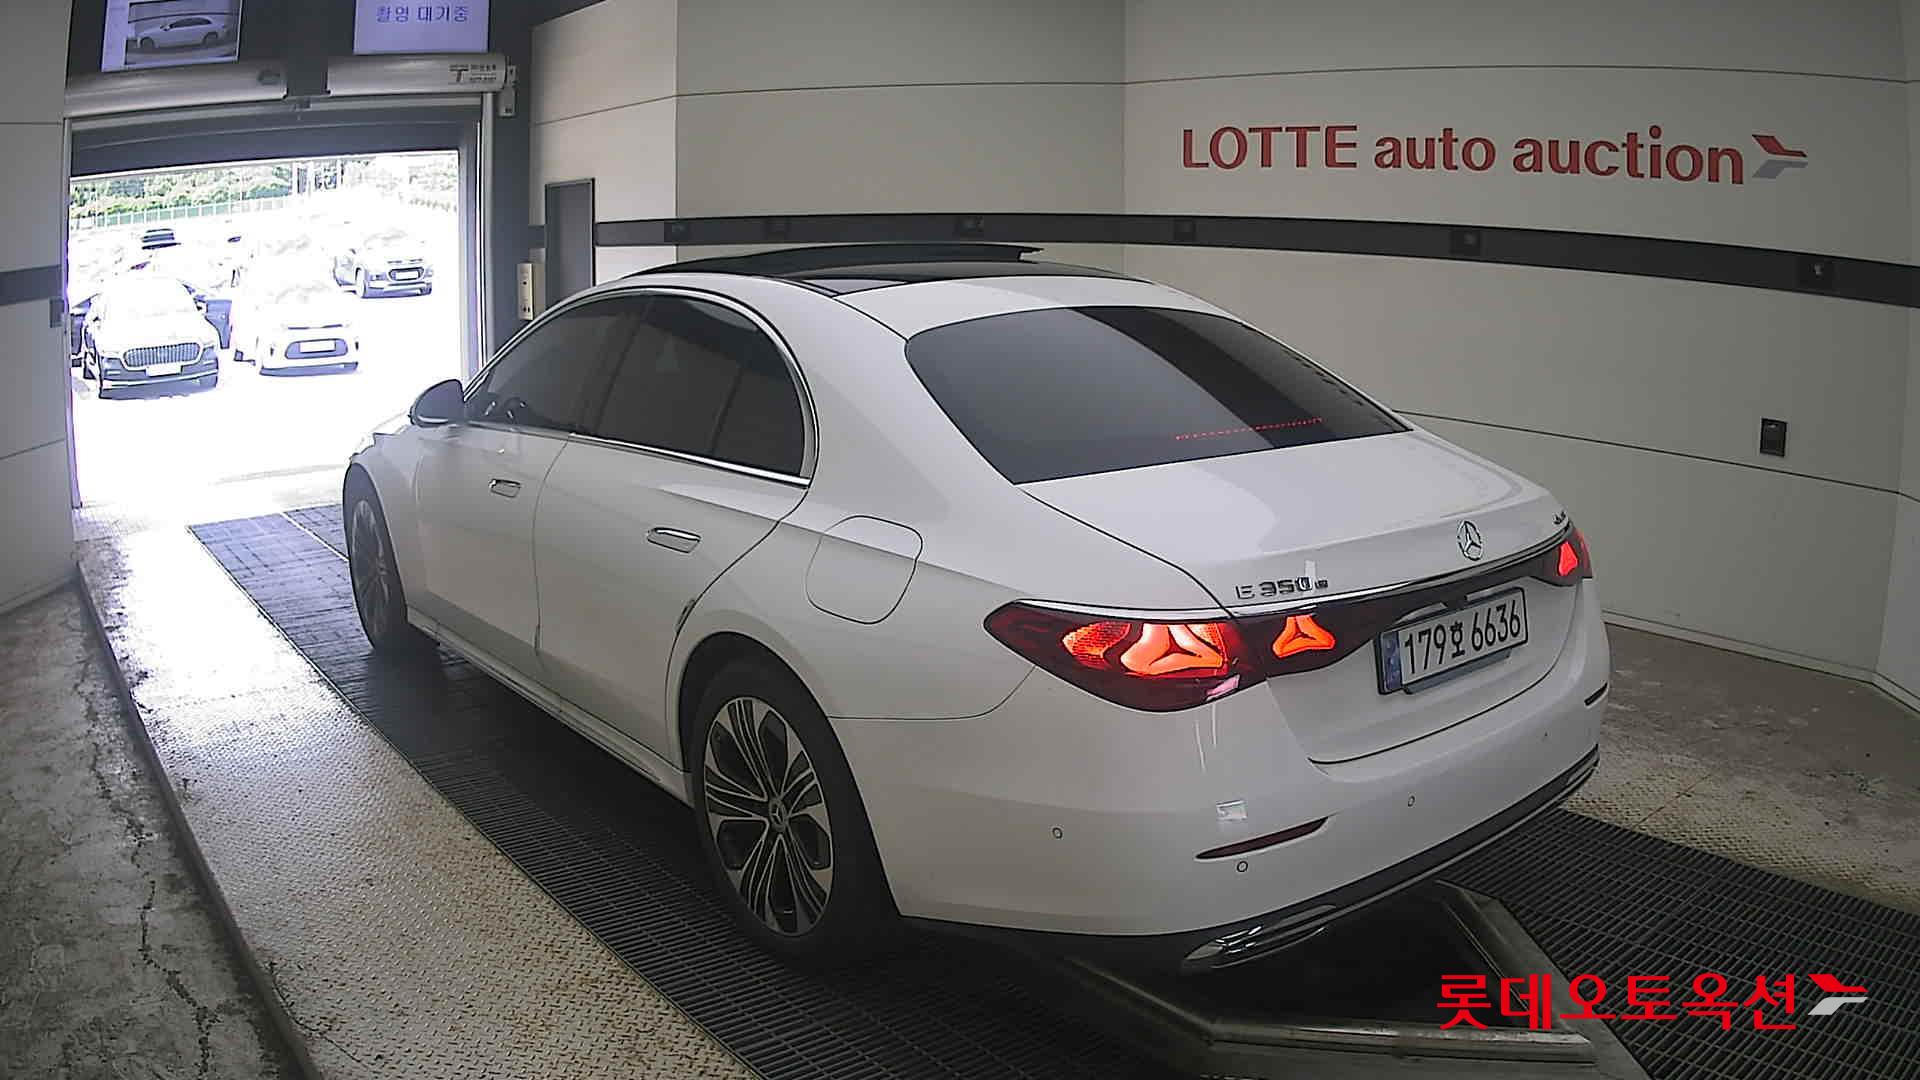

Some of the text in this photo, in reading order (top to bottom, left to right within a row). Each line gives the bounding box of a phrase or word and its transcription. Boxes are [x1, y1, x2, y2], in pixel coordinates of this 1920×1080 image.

[417, 5, 469, 23] 대기중
[1182, 124, 1744, 185] LOTTE auto auction
[1471, 599, 1521, 651] 6636
